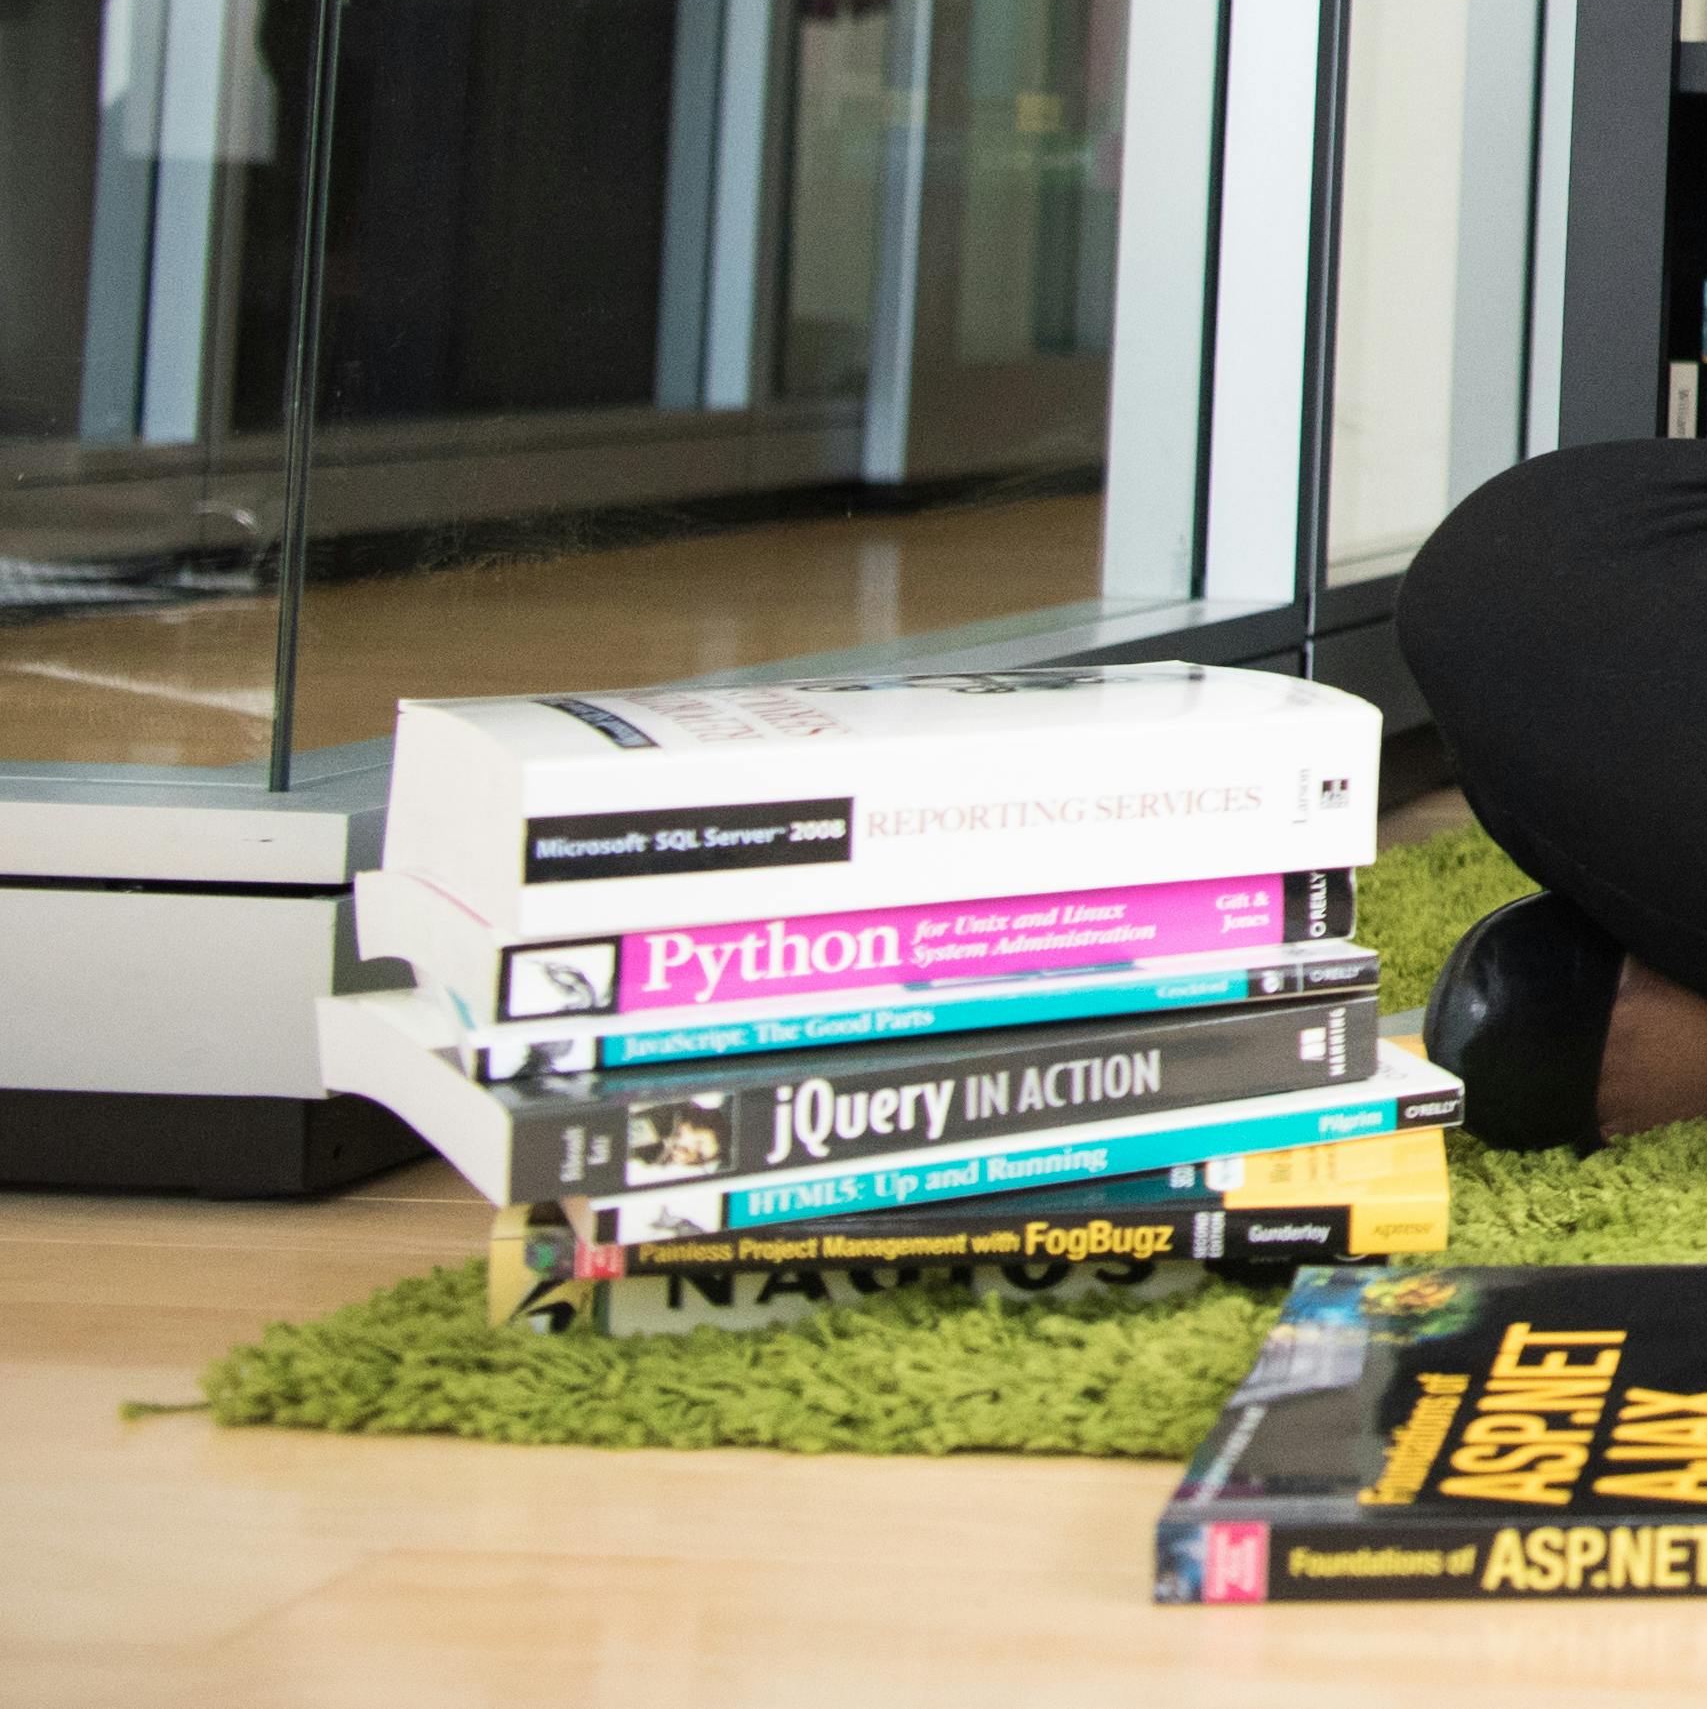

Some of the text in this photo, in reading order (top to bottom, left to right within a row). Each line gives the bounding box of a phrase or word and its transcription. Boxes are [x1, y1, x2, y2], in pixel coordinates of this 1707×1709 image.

[865, 785, 1264, 838] REPORTING SERVICES
[534, 819, 847, 861] Microsoft SQL 2008
[912, 900, 1129, 945] for Unix and Linux
[1216, 891, 1272, 914] Gift &
[1221, 909, 1272, 935] Jones
[643, 919, 902, 1003] Python
[910, 921, 1158, 967] System Administration
[622, 1005, 936, 1061] JavaScript: The Good Parts
[1329, 1007, 1346, 1078] MANNING
[767, 1049, 1162, 1165] jQuery IN ACTION
[1320, 1108, 1383, 1134] Pilgrim
[749, 1144, 1109, 1217] HTML5: Up and Running
[637, 1221, 1174, 1265] Painless Project Management with FogBugz
[1439, 1322, 1628, 1506] ASP.NET
[1287, 1545, 1443, 1579] Foundations
[1445, 1544, 1478, 1577] of
